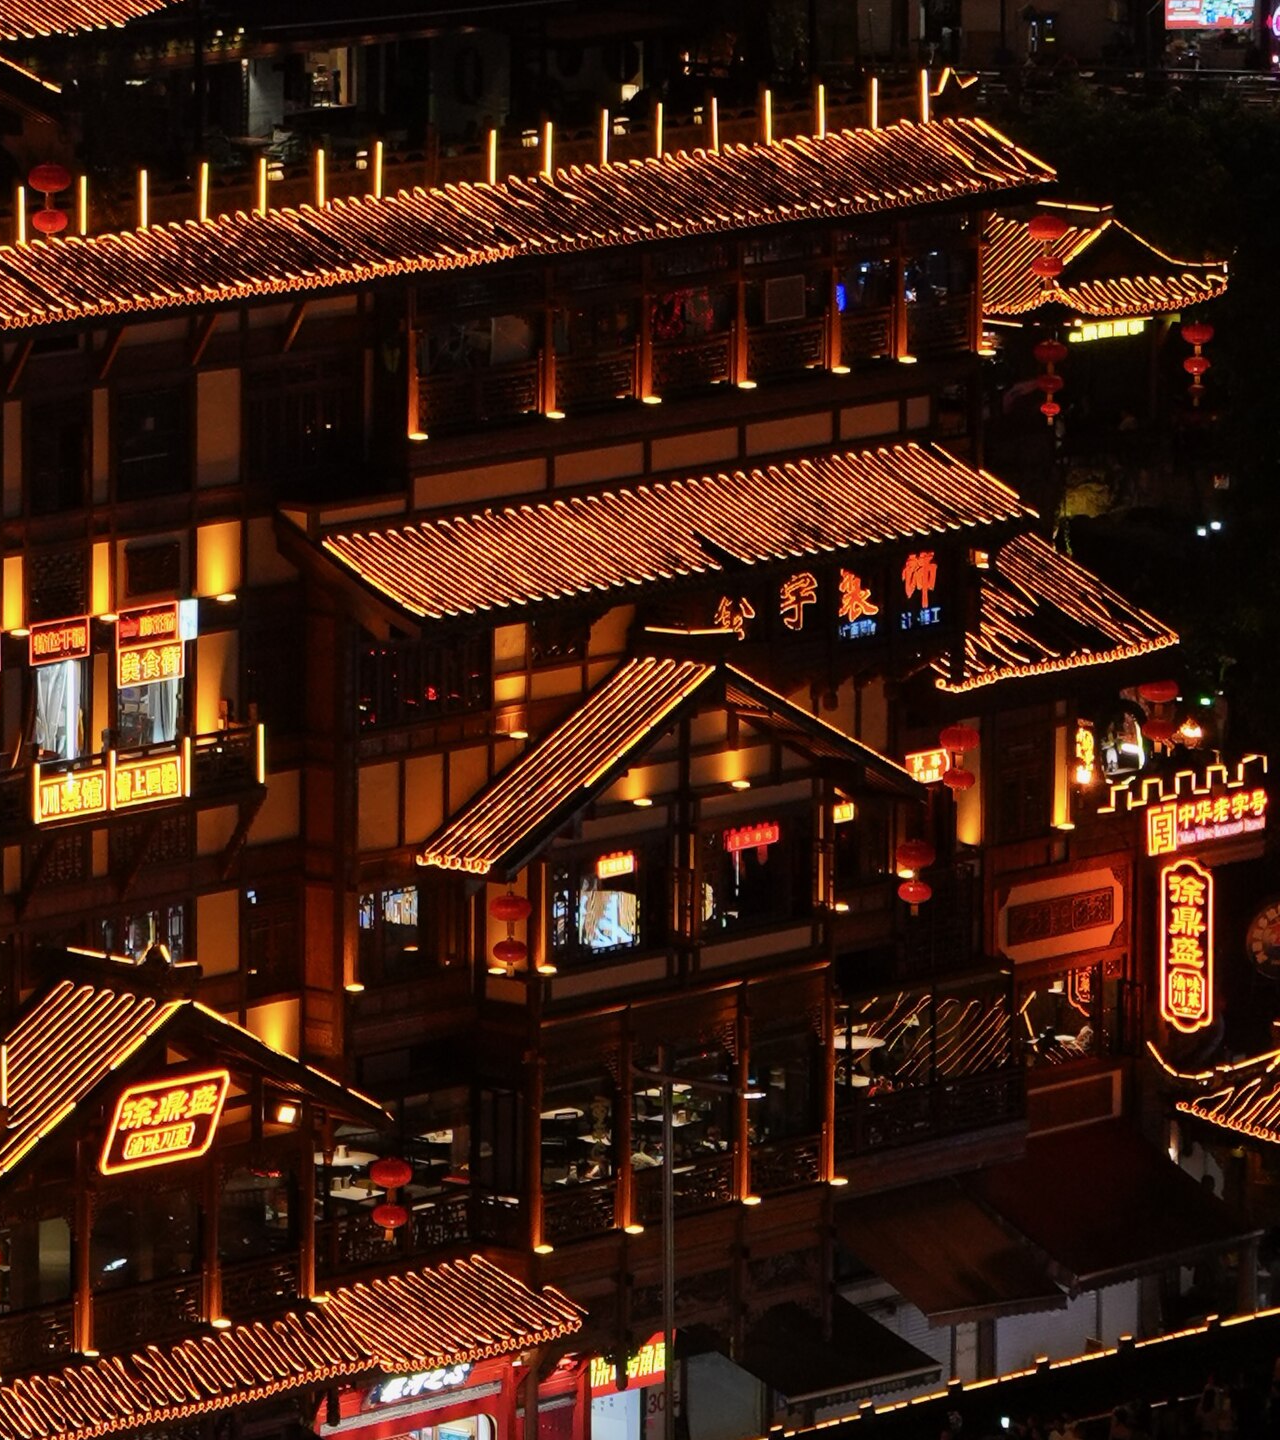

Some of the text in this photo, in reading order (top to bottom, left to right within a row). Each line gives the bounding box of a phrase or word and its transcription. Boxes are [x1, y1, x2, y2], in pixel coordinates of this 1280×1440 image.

[121, 646, 181, 684] 美食街
[42, 777, 103, 815] 川菜馆
[1178, 789, 1268, 829] 中华老字号
[1168, 875, 1206, 968] 徐鼎盛
[118, 1084, 219, 1131] 徐鼎盛
